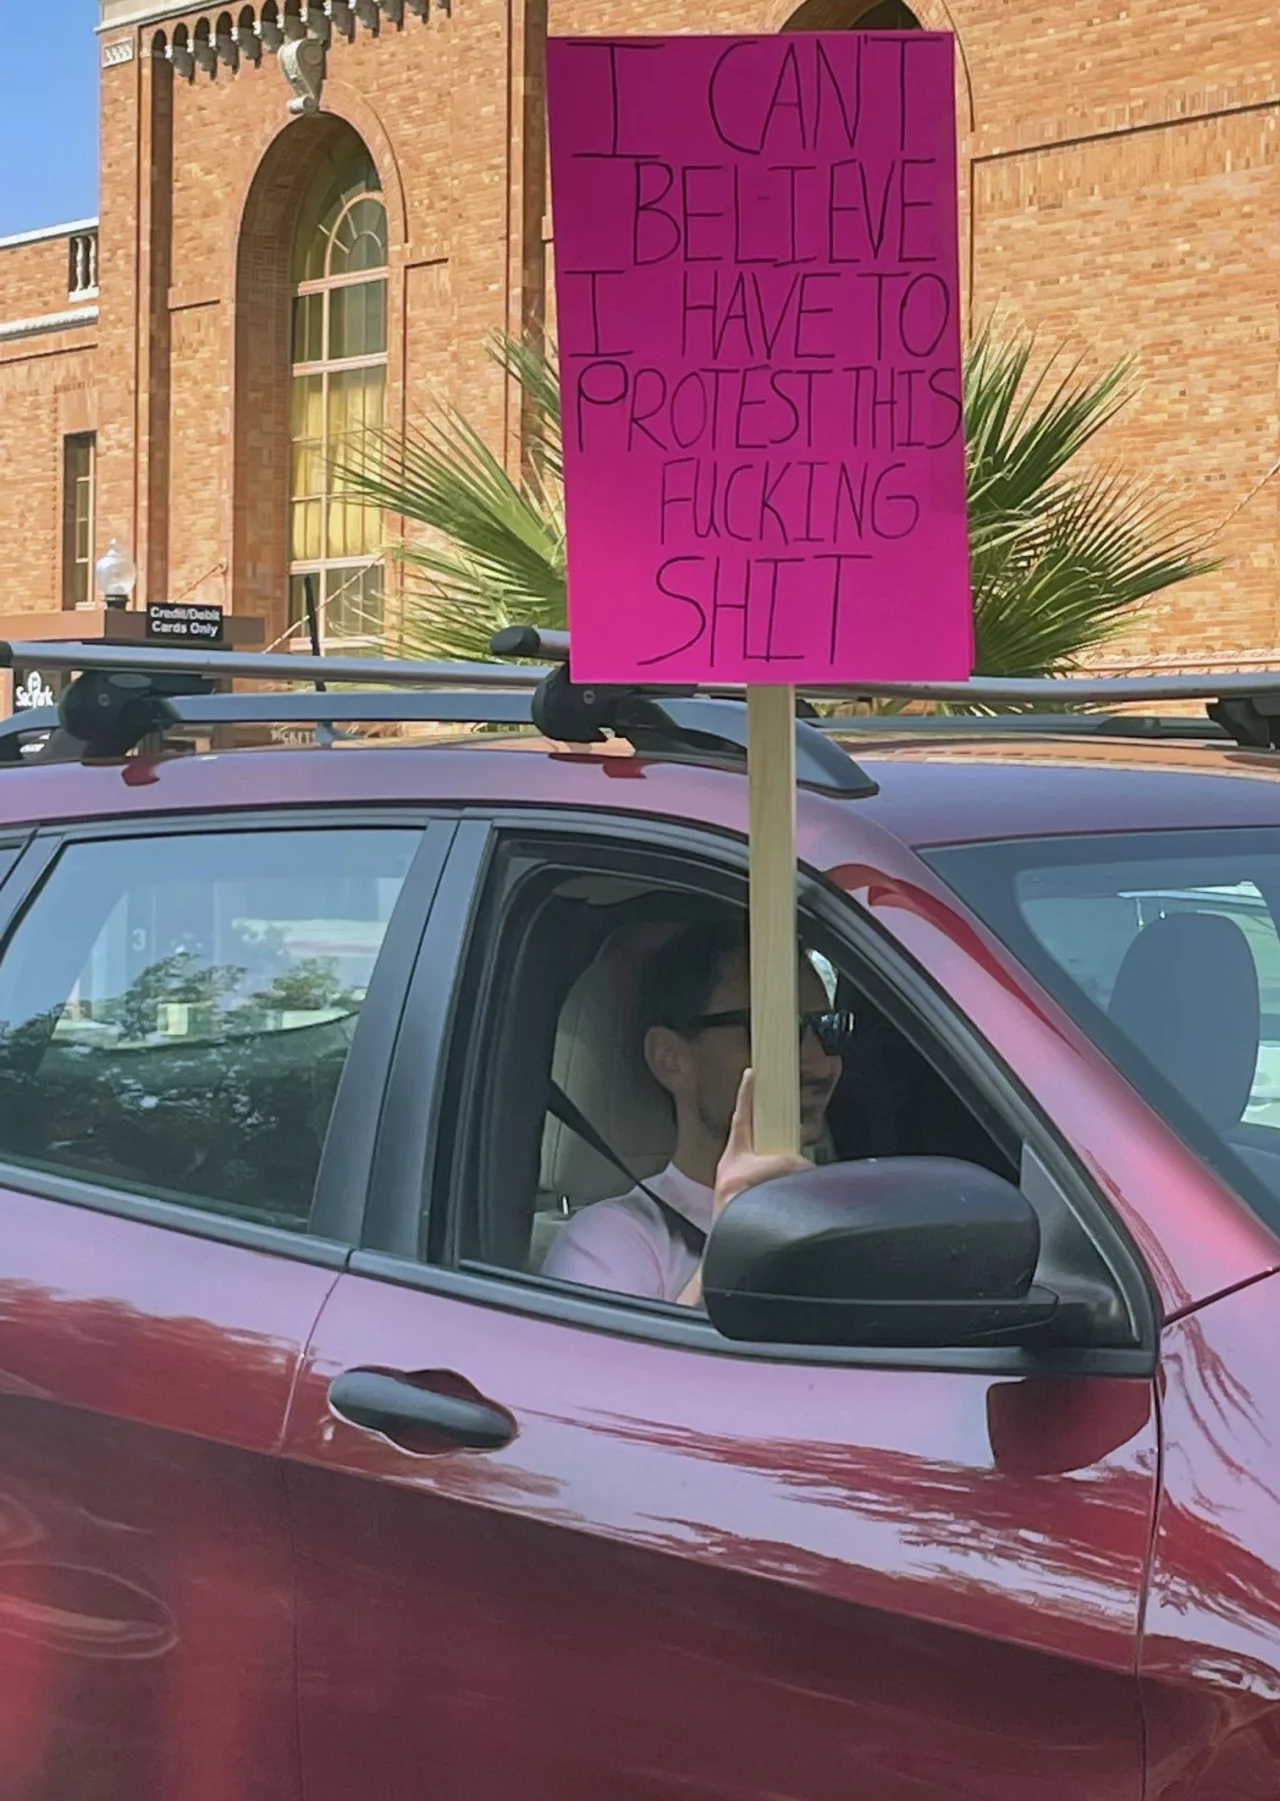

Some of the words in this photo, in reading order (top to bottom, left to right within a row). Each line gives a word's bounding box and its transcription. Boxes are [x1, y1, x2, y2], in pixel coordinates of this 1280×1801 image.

[567, 43, 666, 158] I
[708, 35, 944, 155] CAN'T
[633, 158, 937, 267] BELIEVE
[564, 270, 634, 358] I
[681, 270, 842, 360] HAVE
[856, 272, 950, 361] TO
[577, 360, 834, 452] PROTEST
[842, 365, 963, 452] THIS
[660, 457, 920, 545] FUCKING
[150, 606, 220, 621] Credit/Debit
[152, 620, 188, 634] Cards
[190, 622, 219, 638] Only
[636, 554, 873, 667] SHIT
